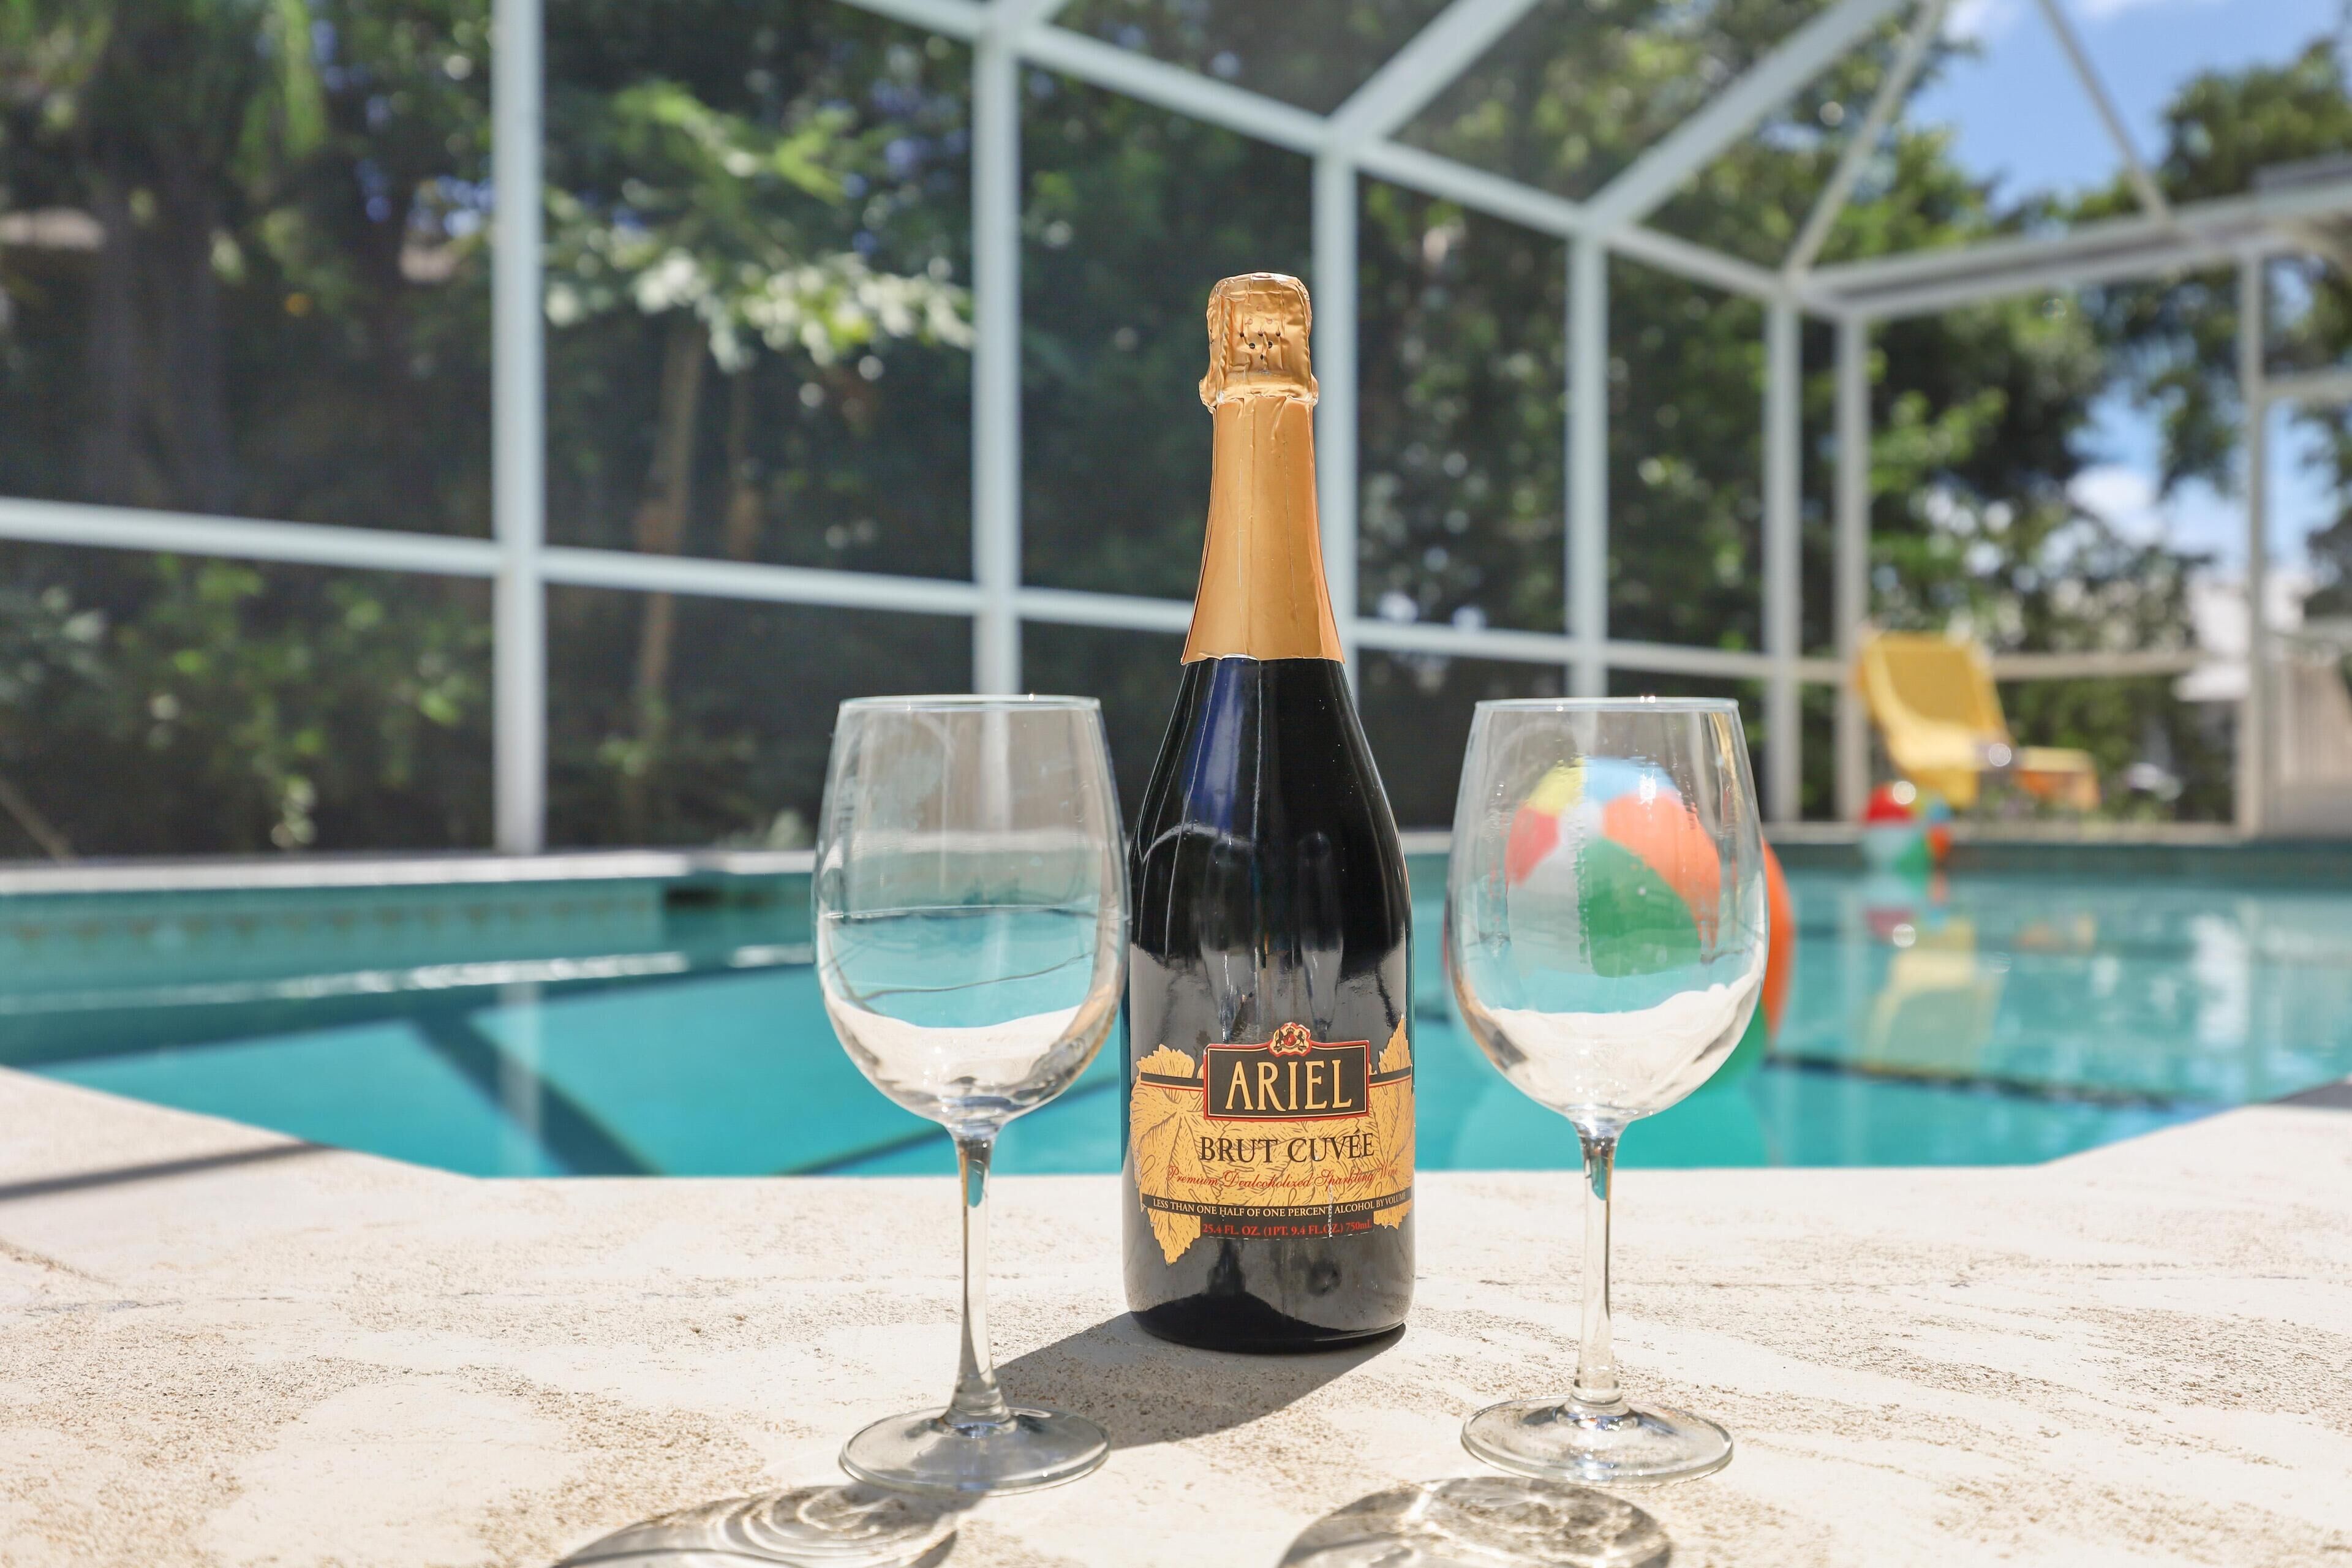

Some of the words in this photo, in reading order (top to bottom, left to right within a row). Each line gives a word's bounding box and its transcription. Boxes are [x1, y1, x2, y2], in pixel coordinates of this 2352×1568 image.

[1225, 1059, 1352, 1112] ARIEL
[1200, 1136, 1278, 1163] BRUT
[1287, 1128, 1375, 1163] CUVÉE
[1166, 1166, 1219, 1187] Premium
[1223, 1170, 1314, 1189] Dealcoholized
[1314, 1169, 1375, 1191] Sparkling
[1376, 1161, 1399, 1179] Wine
[1153, 1198, 1169, 1209] LESS
[1170, 1201, 1194, 1213] THAN
[1196, 1205, 1218, 1215] ONE
[1219, 1207, 1245, 1216] HALF
[1246, 1208, 1261, 1218] OF
[1262, 1208, 1286, 1218] ONE
[1287, 1205, 1333, 1217] PERCENT
[1334, 1201, 1375, 1214] ALCOHOL
[1376, 1198, 1386, 1208] BY
[1385, 1192, 1406, 1206] VOLUME
[1202, 1223, 1222, 1234] 25.4
[1224, 1224, 1239, 1235] FL.
[1242, 1226, 1261, 1235] OZ.
[1291, 1225, 1306, 1235] 9.4
[1346, 1219, 1373, 1232] 750mL
